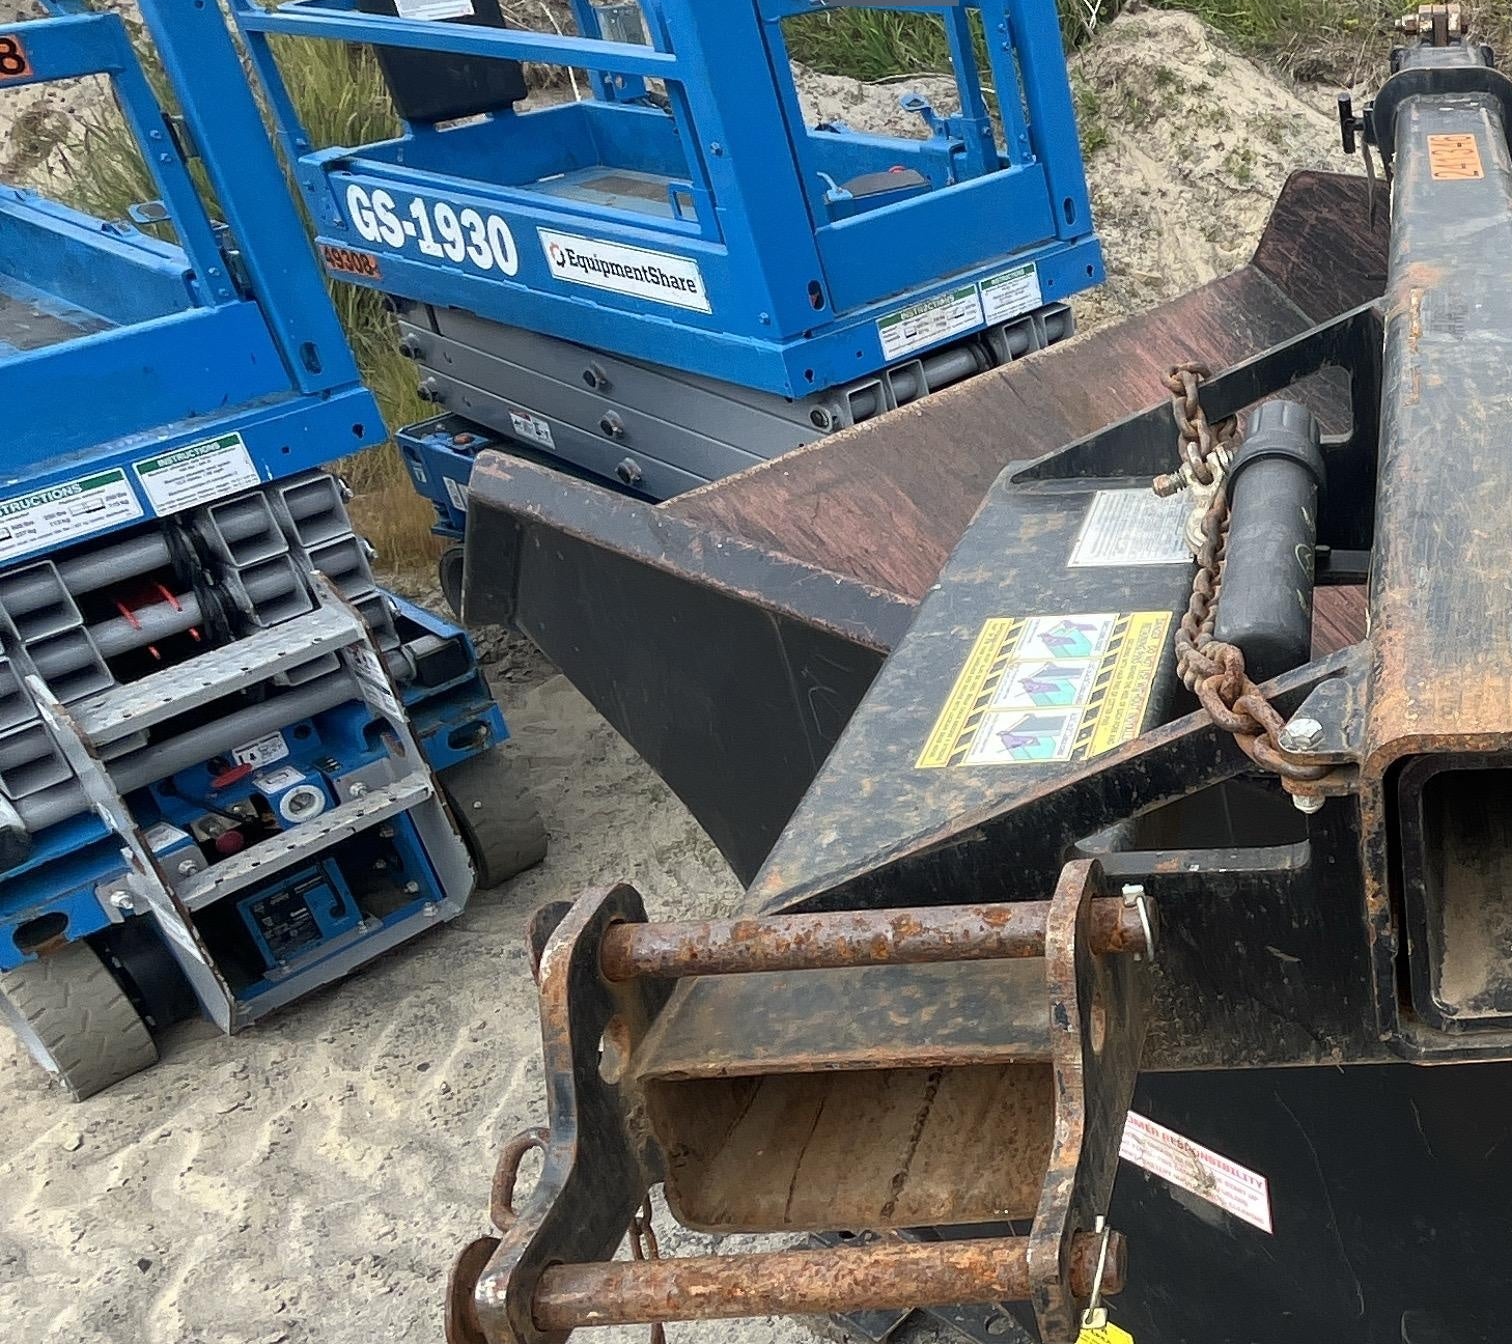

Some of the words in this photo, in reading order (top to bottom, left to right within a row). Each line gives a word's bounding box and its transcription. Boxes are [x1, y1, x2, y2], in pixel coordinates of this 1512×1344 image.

[346, 183, 519, 277] GS-1930
[566, 247, 698, 295] EquipmentShare
[1161, 1131, 1263, 1188] RESPONSIBILITY
